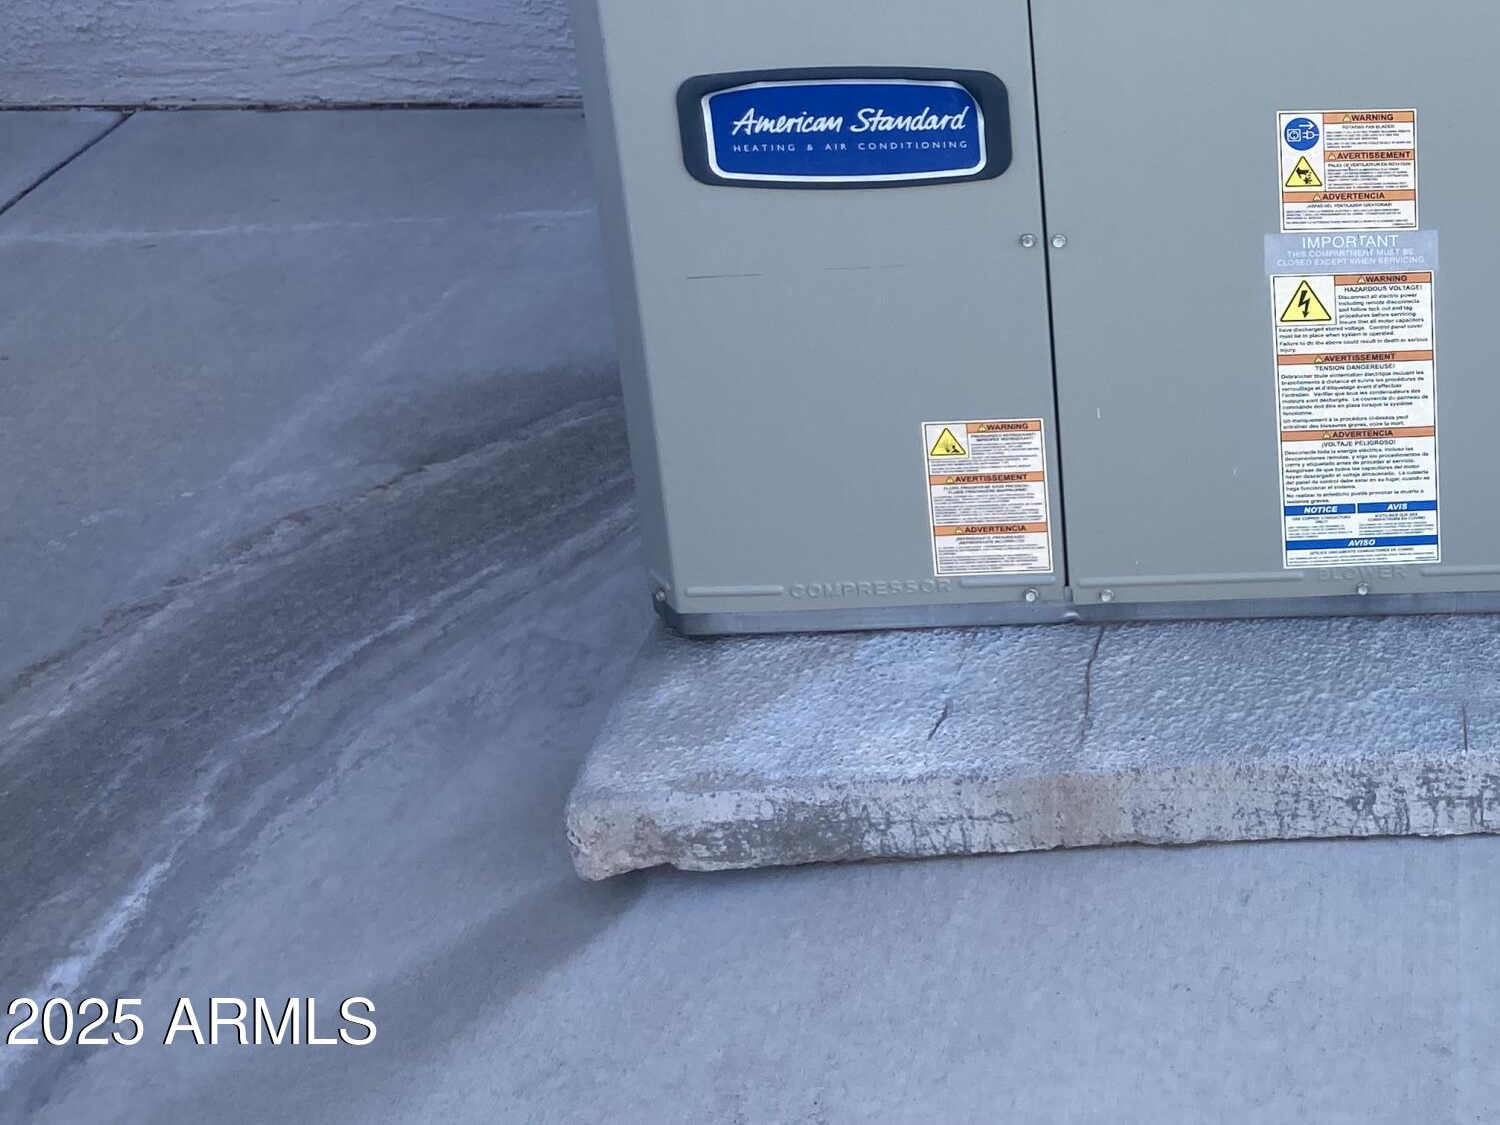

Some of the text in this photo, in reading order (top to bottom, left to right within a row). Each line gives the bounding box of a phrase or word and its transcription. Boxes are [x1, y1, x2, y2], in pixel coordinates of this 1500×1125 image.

[732, 106, 970, 135] American Standard
[733, 144, 796, 152] HEATING
[858, 141, 968, 150] CONDITIONING
[1302, 235, 1399, 248] IMPORTANT
[1309, 249, 1373, 257] COMPARTMENT
[1277, 256, 1424, 266] CLOSED EXCEPT WHEN SERVICING
[1324, 353, 1396, 362] AVERTISSEMENT
[955, 474, 1027, 482] AVERTISSEMENT
[1318, 566, 1408, 581] BLOWER
[790, 578, 952, 599] COMPRESSOR
